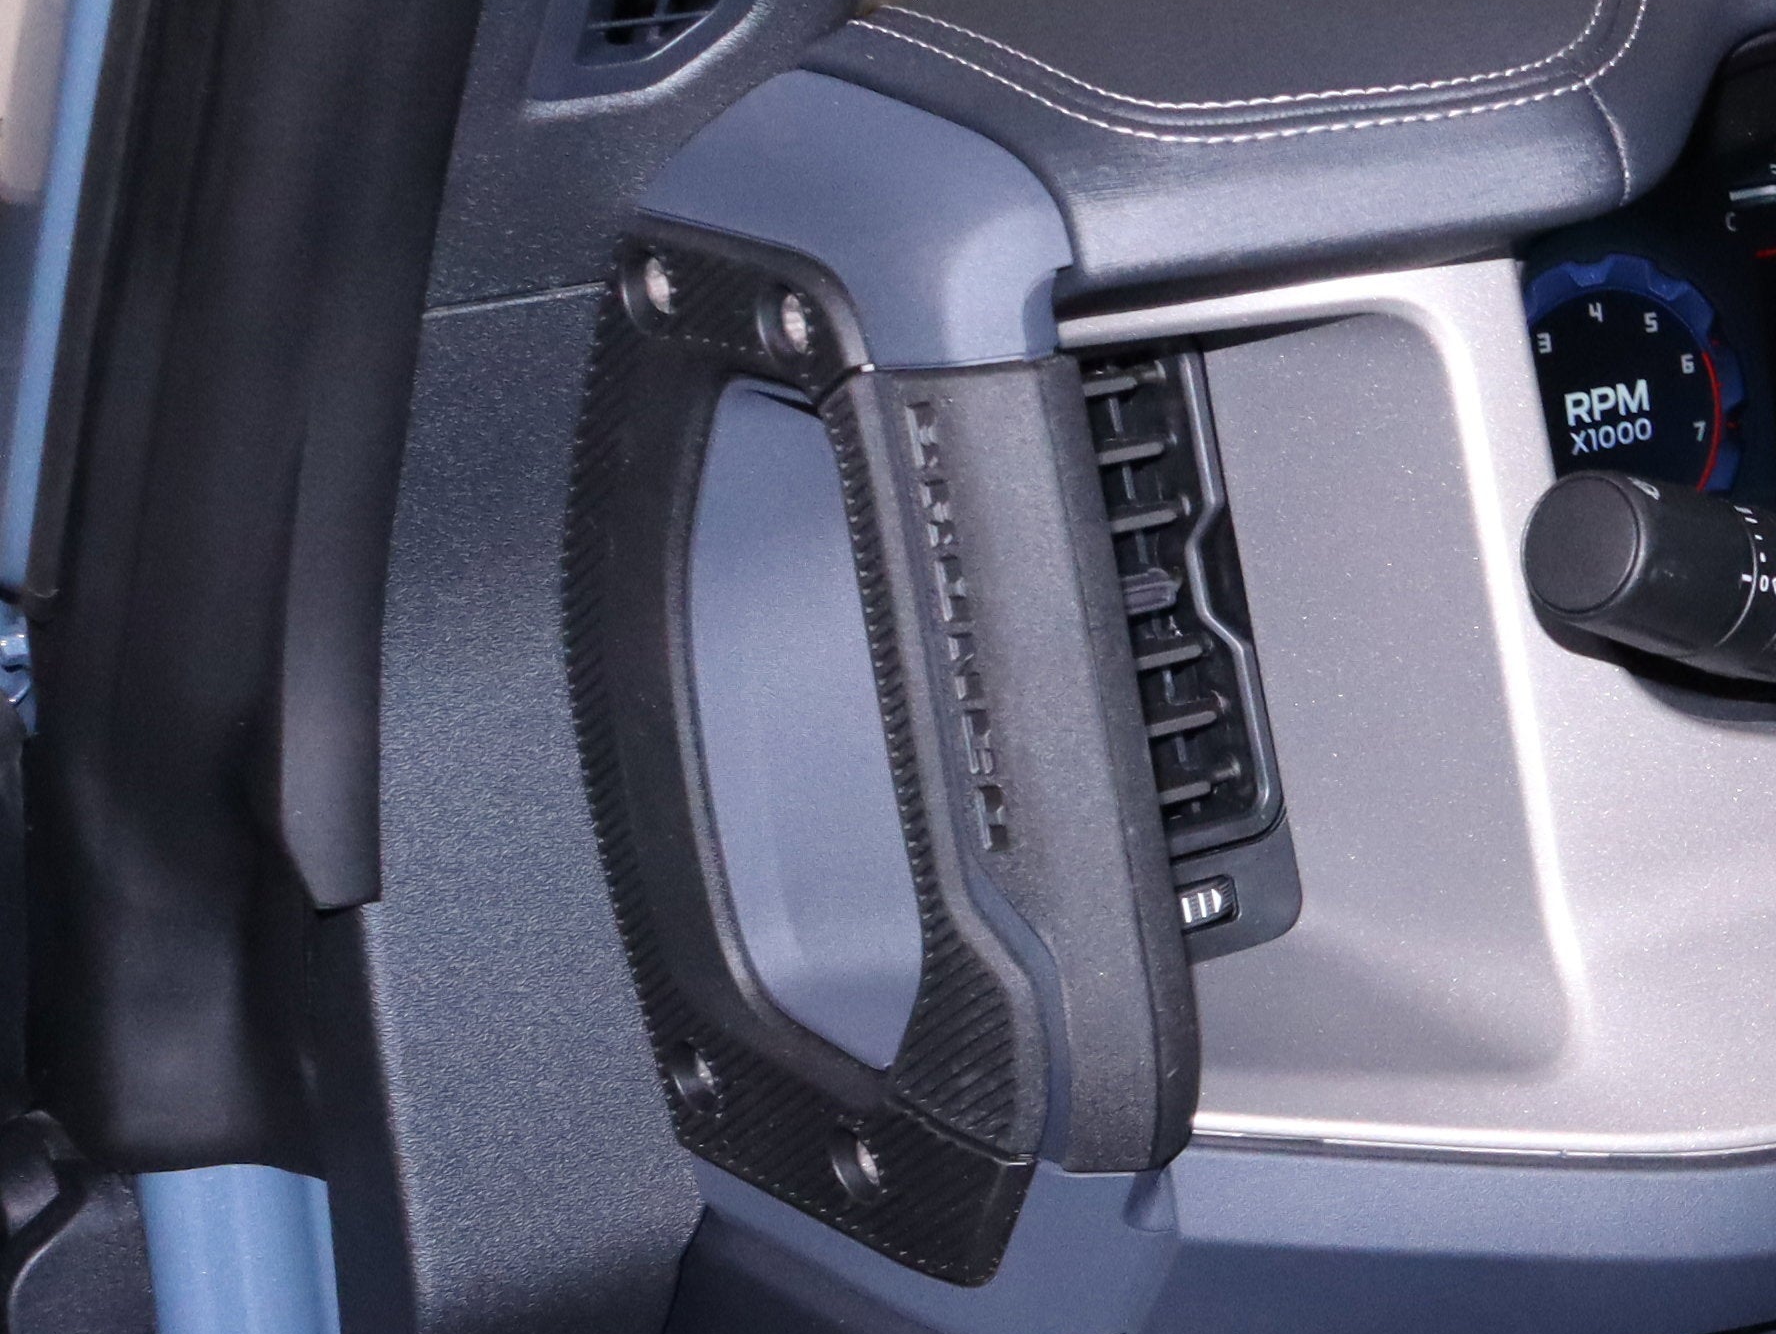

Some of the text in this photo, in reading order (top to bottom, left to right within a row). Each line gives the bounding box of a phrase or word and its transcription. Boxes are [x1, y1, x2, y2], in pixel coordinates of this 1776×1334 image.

[1588, 301, 1604, 323] 4
[1643, 311, 1659, 333] 5
[1535, 331, 1553, 355] 3
[1680, 353, 1696, 375] 6
[1563, 378, 1651, 428] RPM
[1568, 417, 1653, 457] X1000
[1692, 419, 1707, 443] 7
